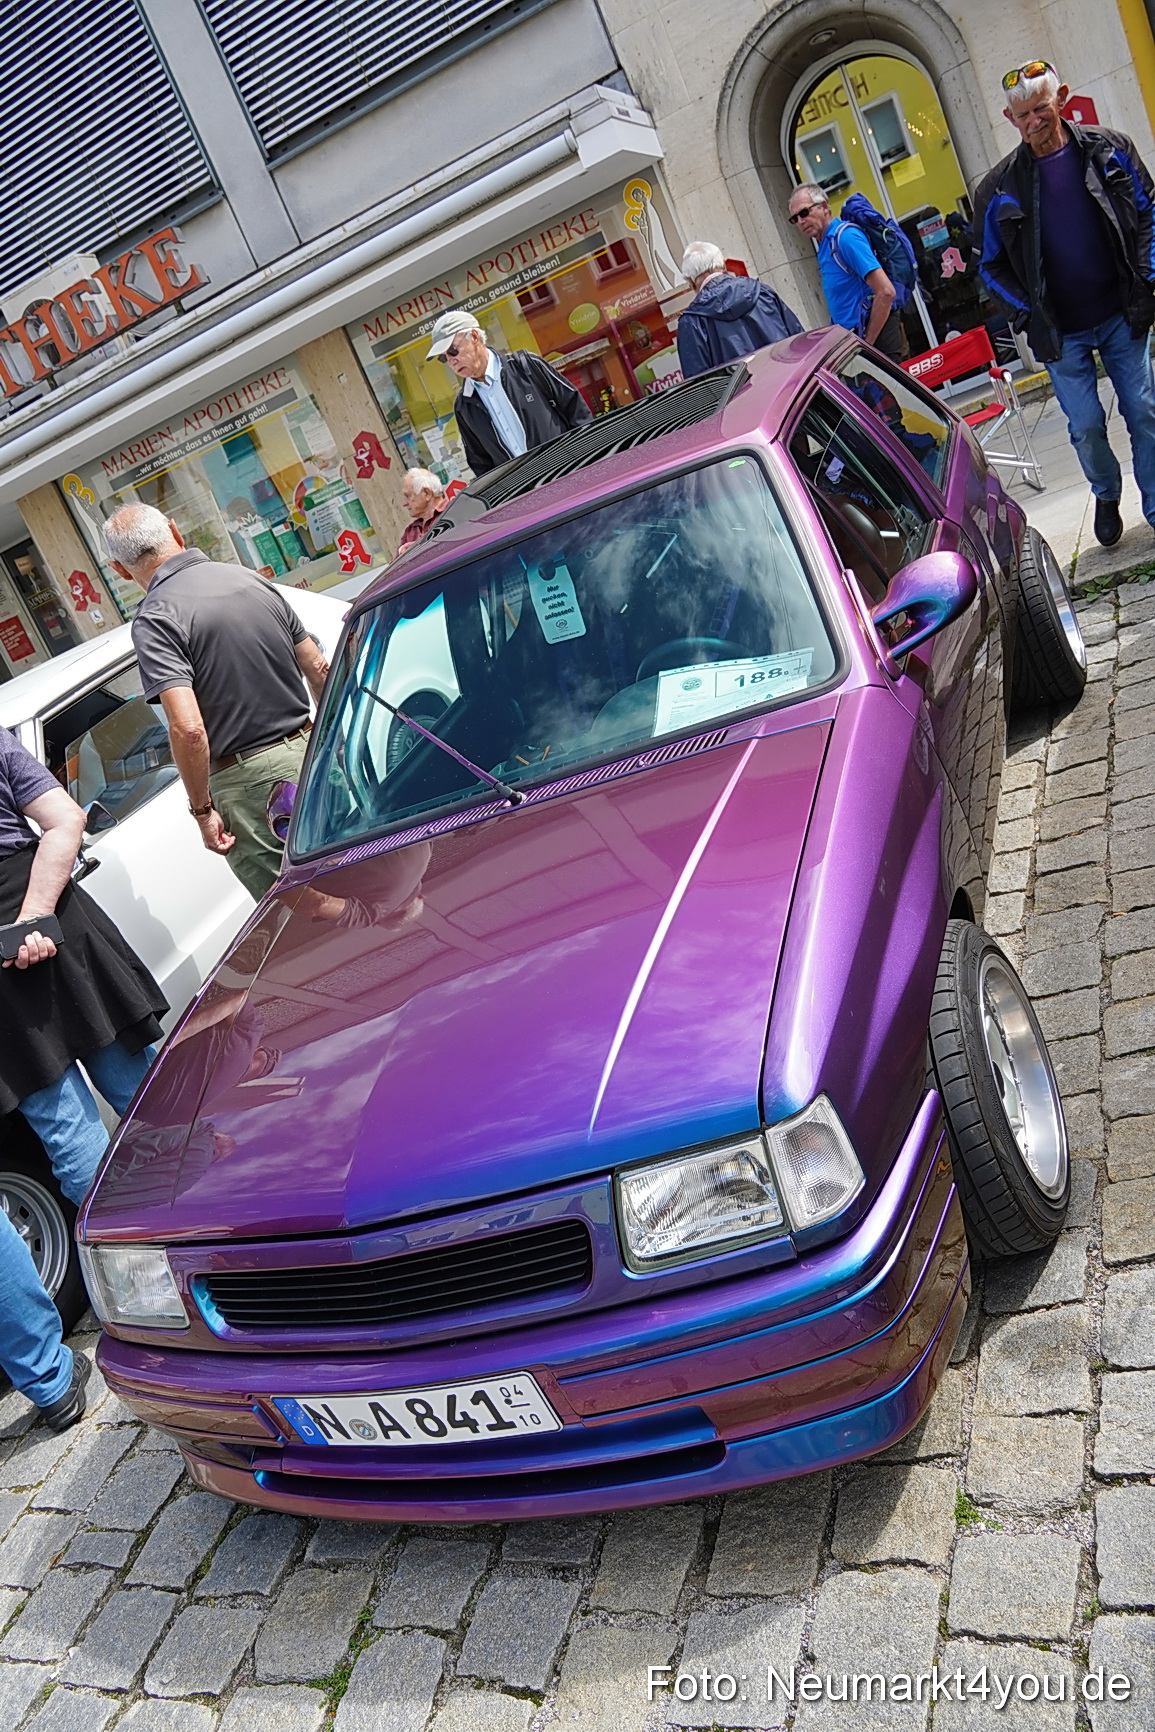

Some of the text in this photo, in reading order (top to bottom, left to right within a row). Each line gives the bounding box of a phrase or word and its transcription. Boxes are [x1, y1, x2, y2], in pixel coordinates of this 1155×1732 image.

[362, 207, 600, 342] MARIEN APOTHEKE
[489, 273, 521, 300] gesund
[522, 256, 561, 282] bleiben!
[570, 310, 596, 326] Vividrin
[908, 353, 943, 377] BBS
[645, 370, 684, 395] Vivid
[101, 426, 175, 477] MARIEN
[184, 367, 292, 436] APOTHEKE
[153, 448, 186, 470] möchten,
[186, 439, 202, 452] dass
[203, 435, 212, 443] es
[211, 424, 234, 438] Ihnen
[235, 415, 248, 430] gut
[249, 403, 268, 421] geht!
[548, 600, 565, 610] nicht
[734, 668, 782, 688] 188
[499, 1385, 524, 1399] 04
[302, 1403, 352, 1440] N
[302, 1425, 314, 1437] D
[519, 1413, 542, 1428] 10
